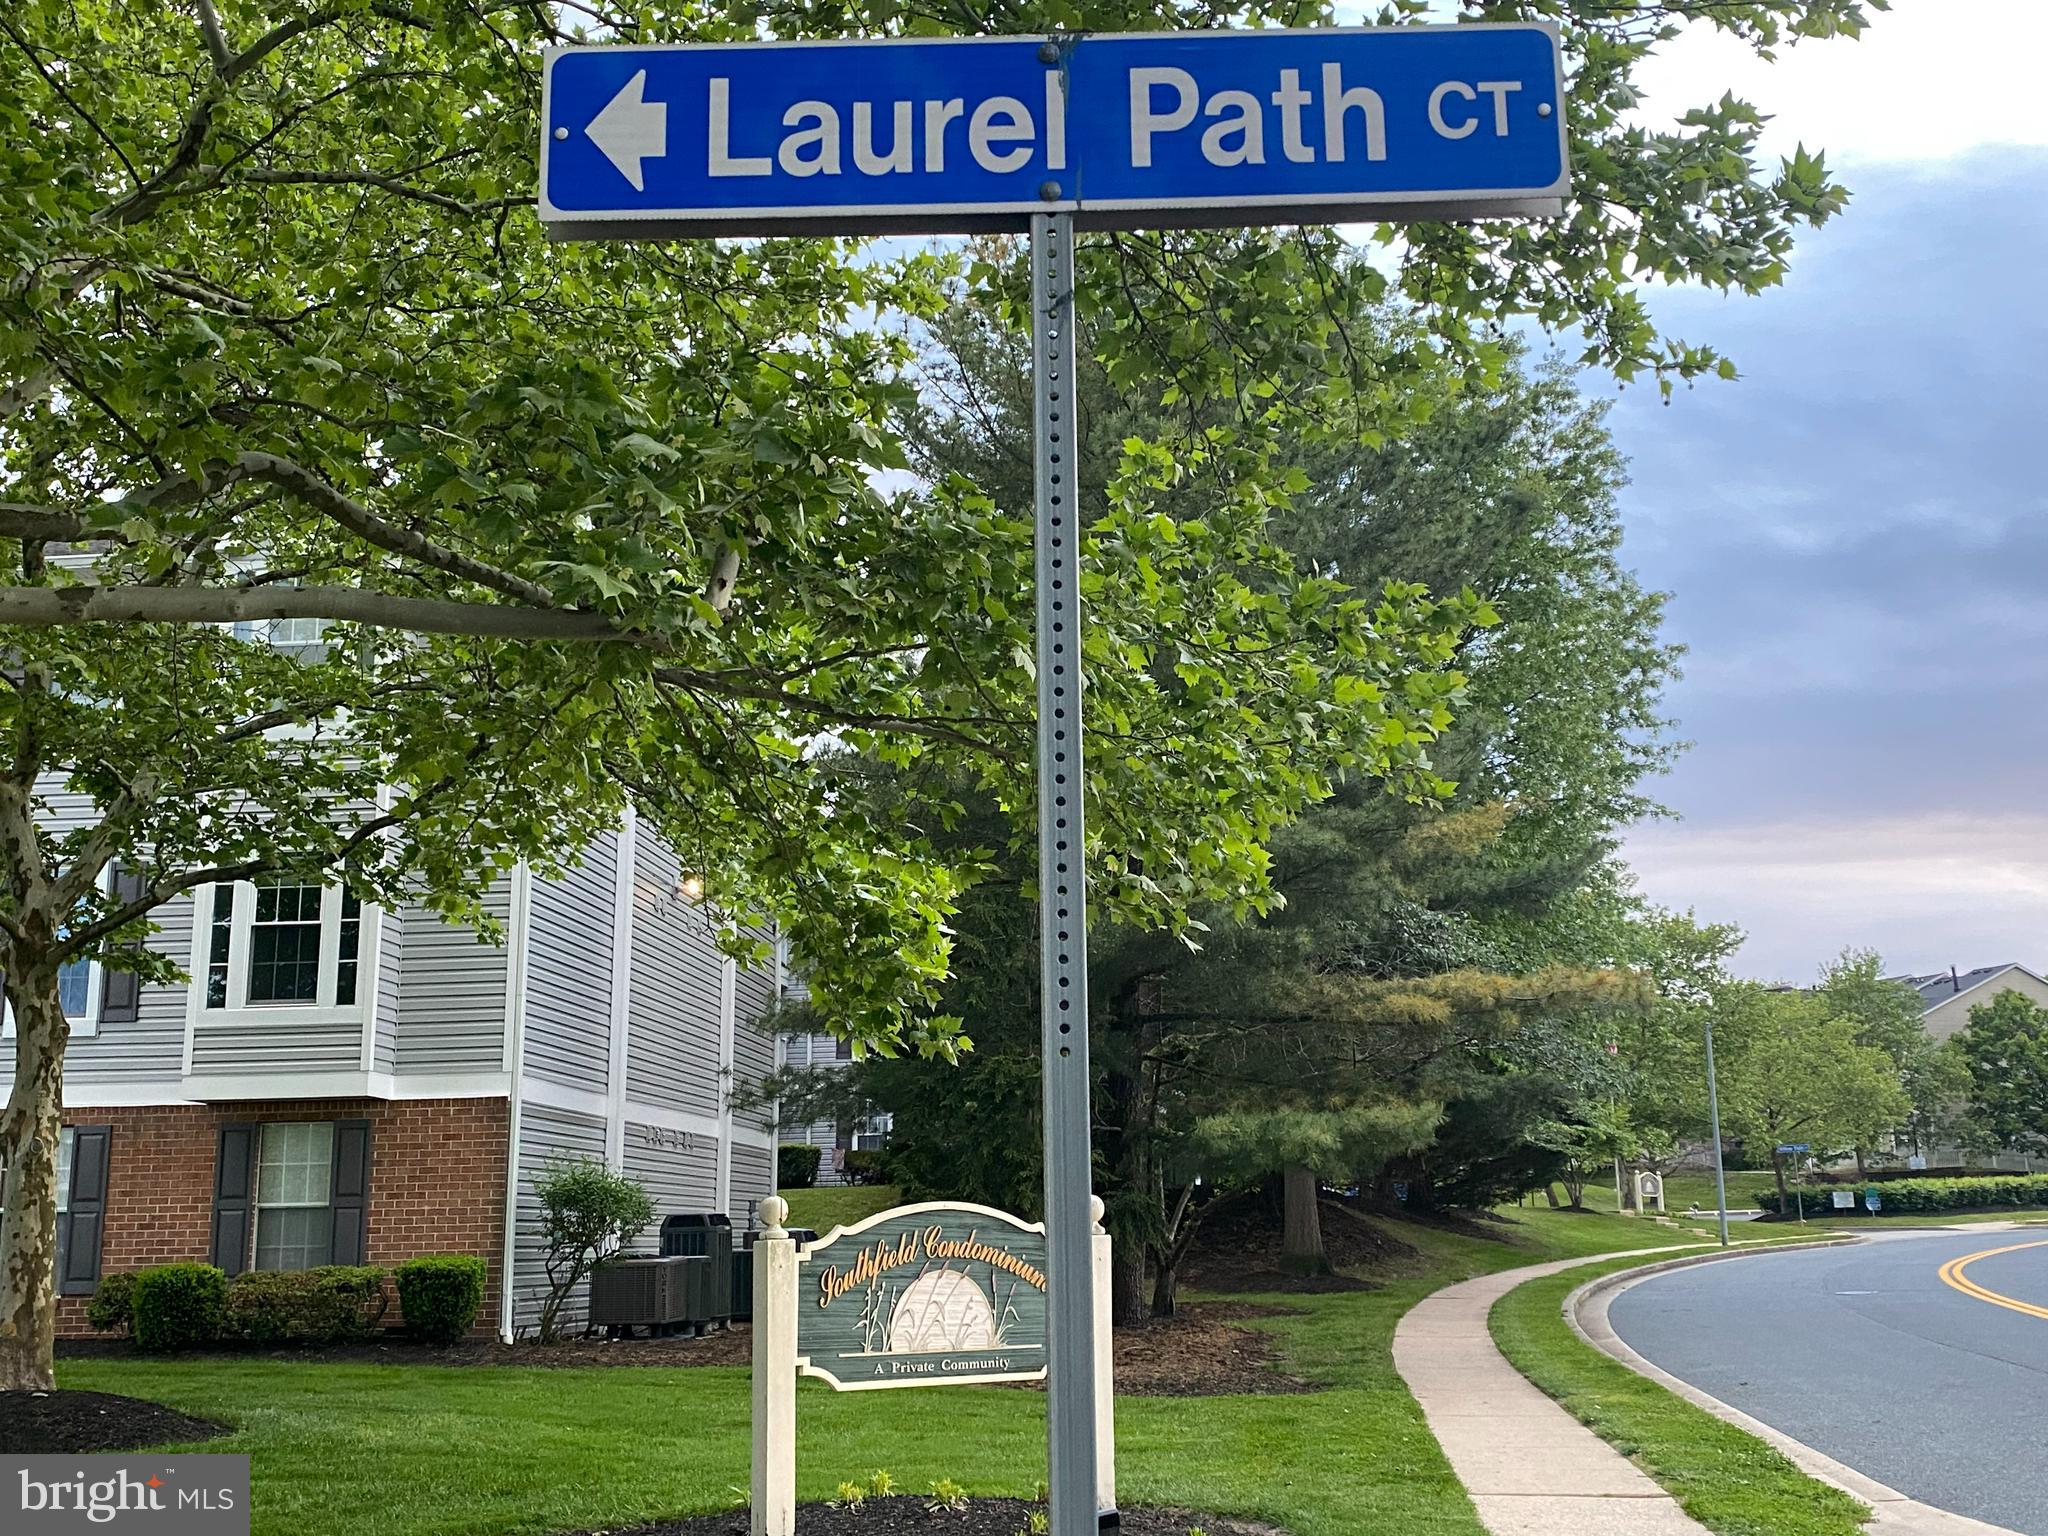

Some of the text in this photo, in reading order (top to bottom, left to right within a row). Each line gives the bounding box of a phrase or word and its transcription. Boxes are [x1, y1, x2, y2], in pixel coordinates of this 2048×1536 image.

[708, 62, 1522, 177] Laurel Path CT
[819, 1230, 920, 1309] Southfield
[874, 1356, 1011, 1375] A Private Community
